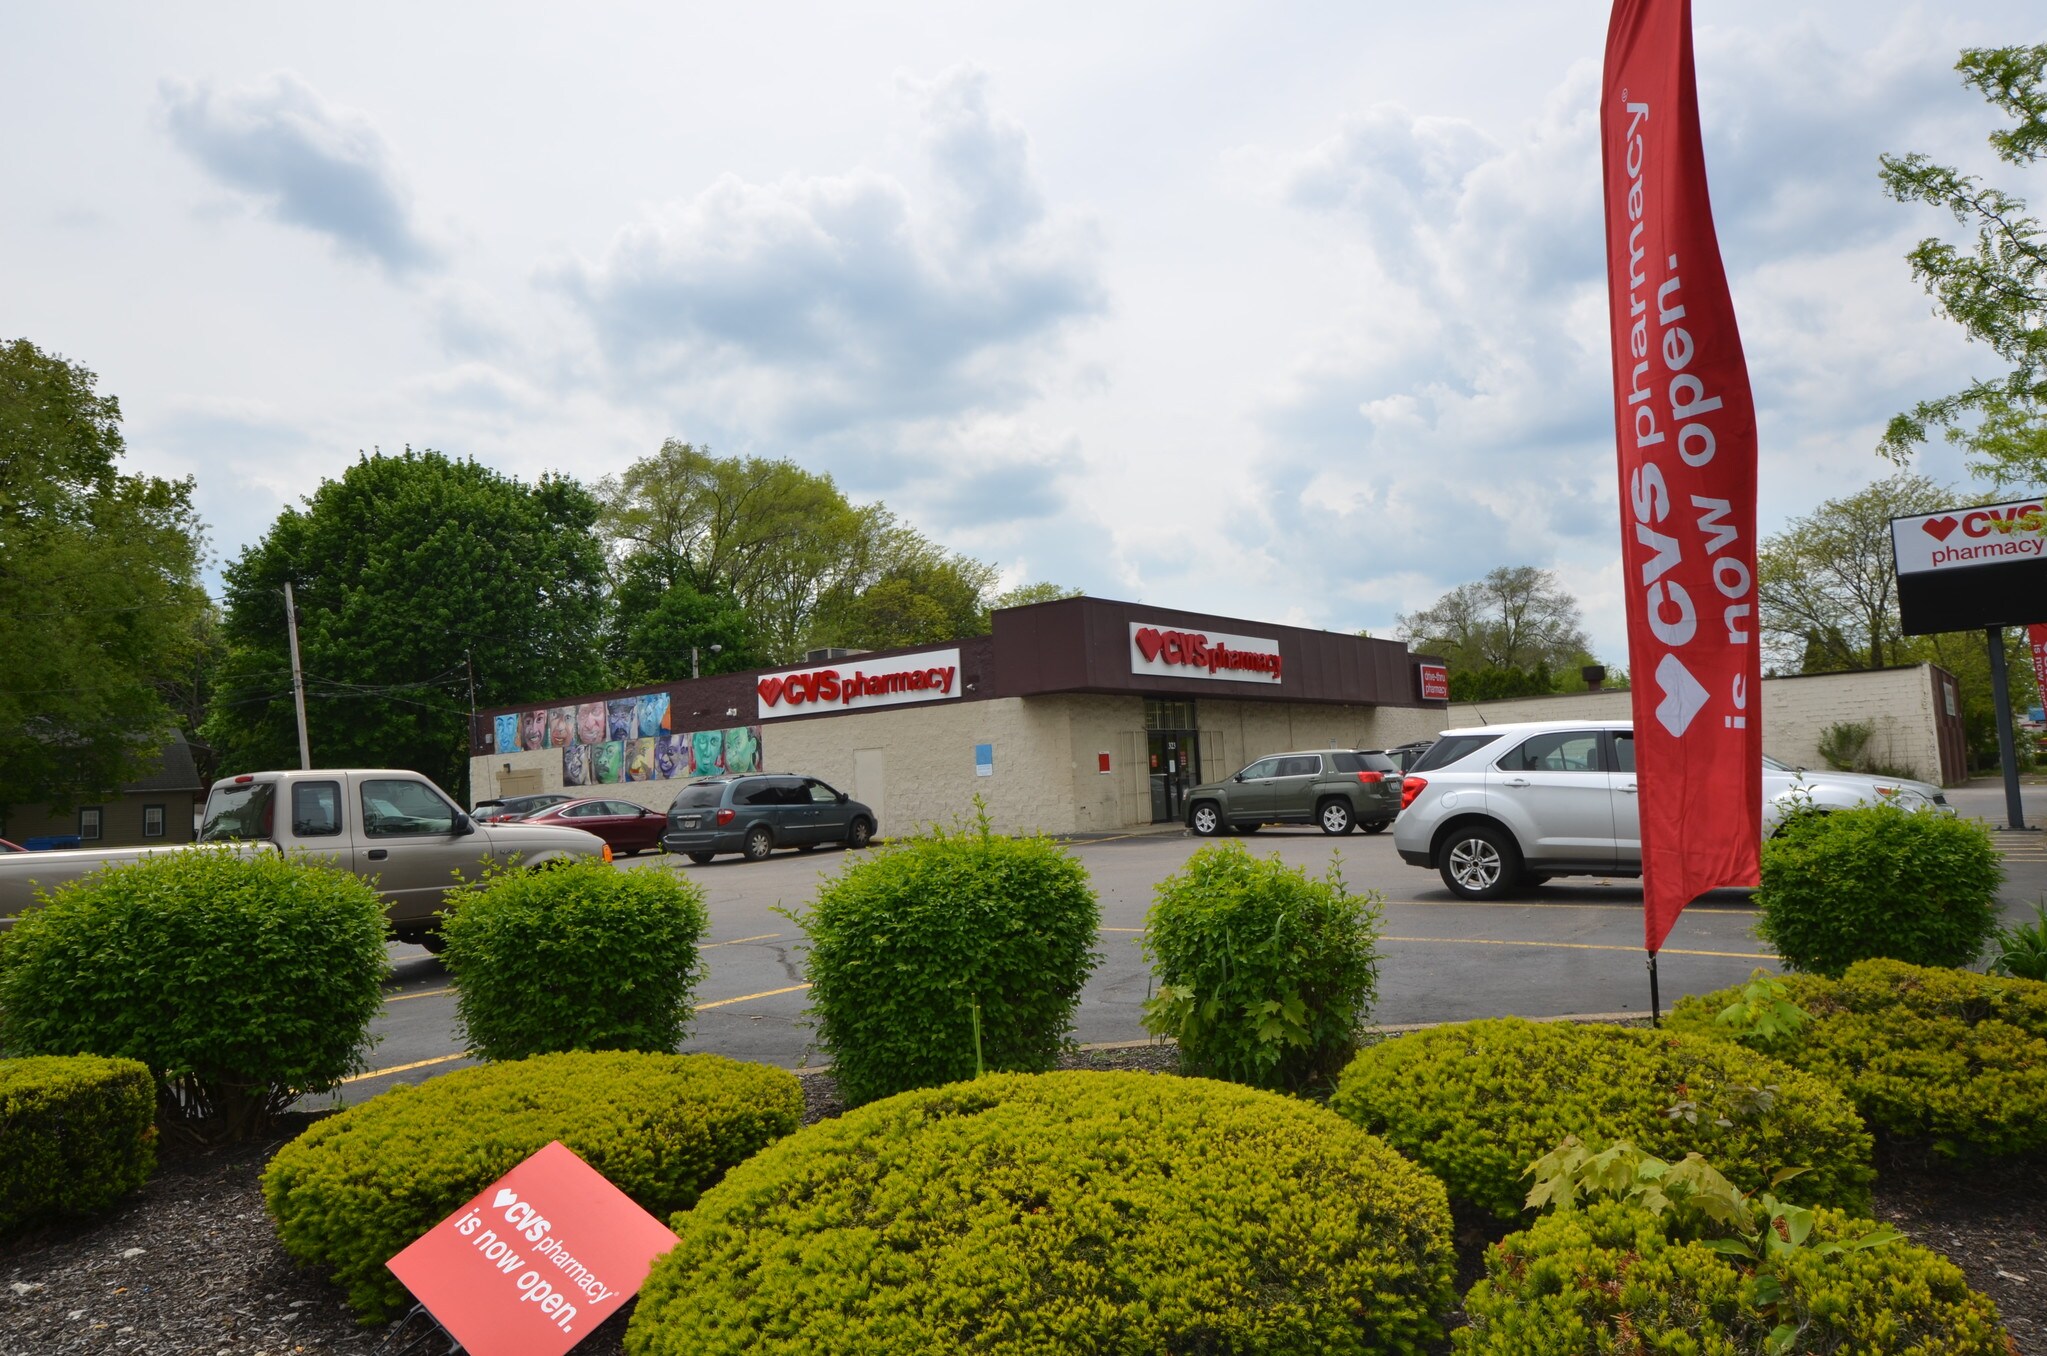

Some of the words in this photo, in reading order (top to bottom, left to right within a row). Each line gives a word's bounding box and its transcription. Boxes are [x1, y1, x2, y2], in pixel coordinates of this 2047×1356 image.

[1658, 253, 1722, 467] open.
[1631, 462, 1697, 646] CVS
[1932, 538, 2045, 567] pharmacy
[1962, 505, 2043, 538] CVS
[1691, 494, 1750, 644] now
[783, 670, 841, 705] CVS
[841, 666, 955, 705] pharmacy
[1161, 631, 1208, 667] CVS
[1208, 642, 1282, 679] pharmacy
[1425, 683, 1447, 697] pharmacy
[454, 1208, 482, 1236] is
[473, 1229, 526, 1274] now
[517, 1270, 578, 1334] open.
[504, 1201, 551, 1242] CVS
[532, 1239, 613, 1304] pharmacy
